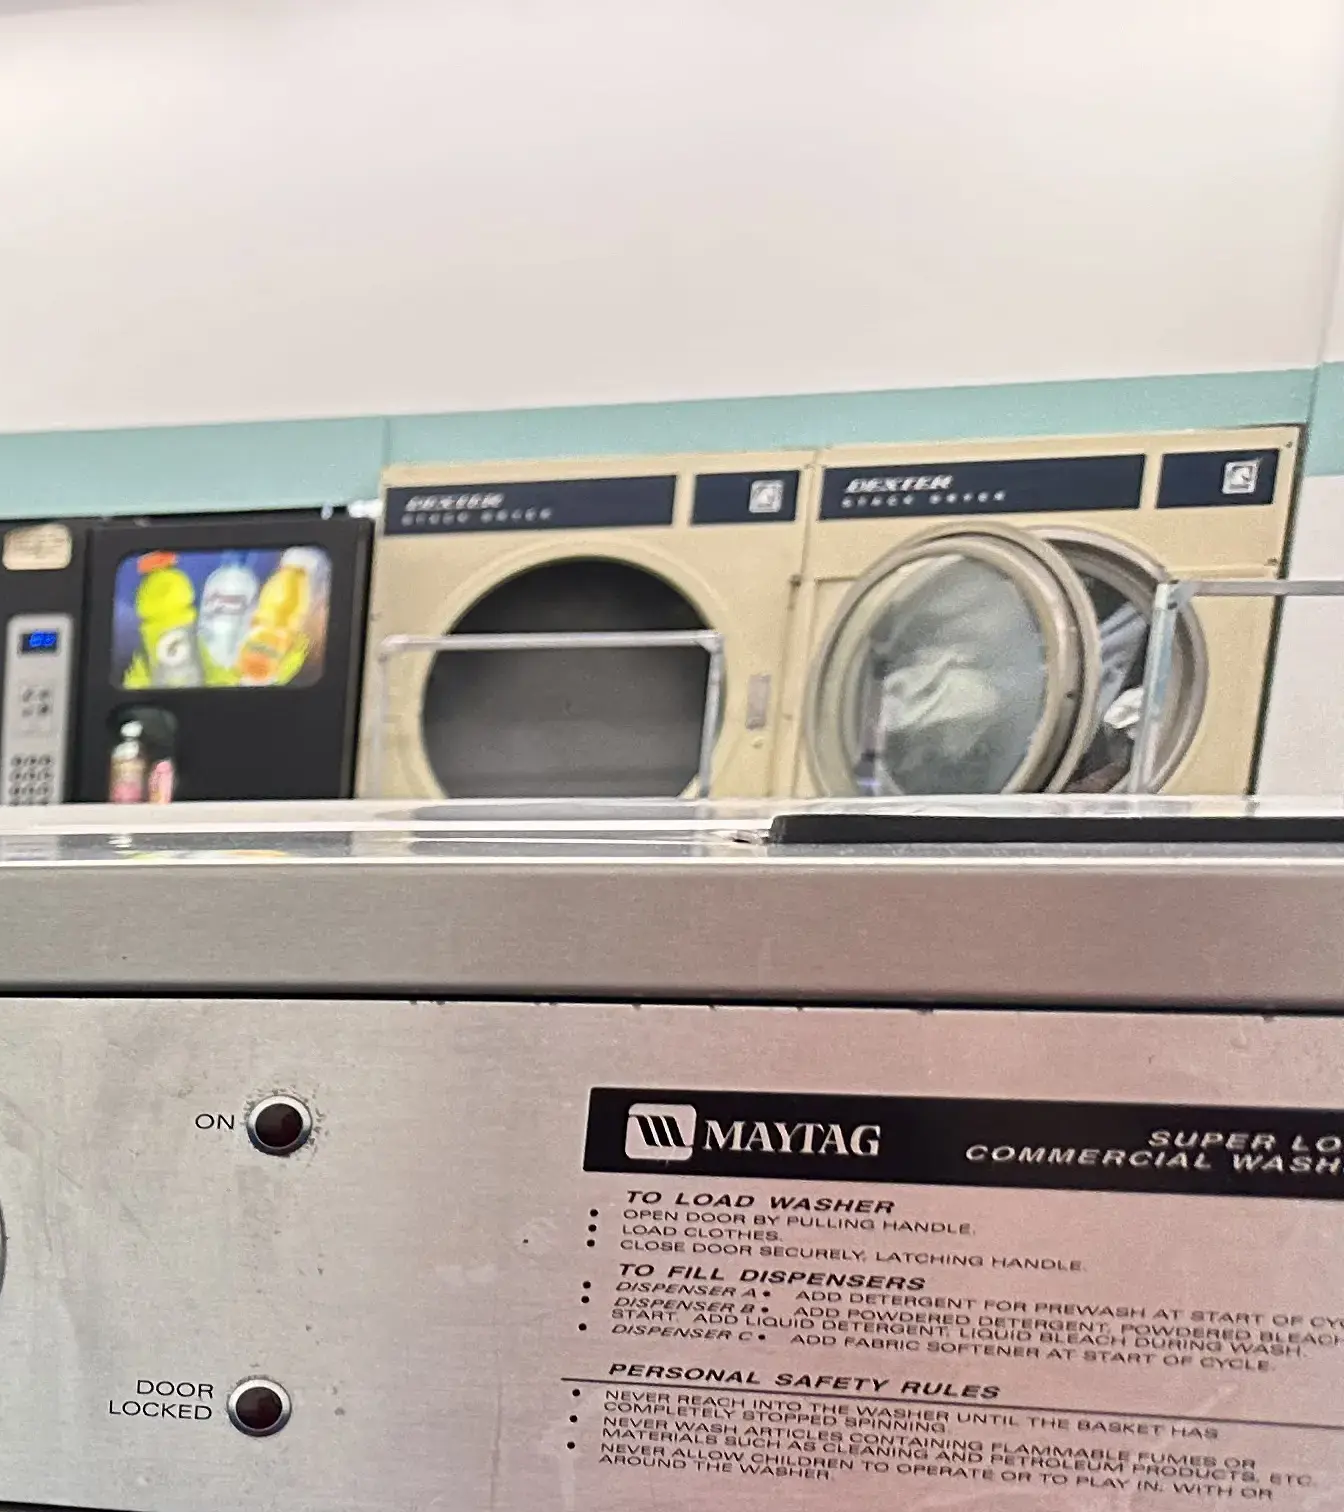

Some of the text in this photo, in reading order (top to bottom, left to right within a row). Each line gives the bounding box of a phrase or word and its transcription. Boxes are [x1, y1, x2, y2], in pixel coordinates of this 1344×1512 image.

[845, 475, 954, 493] DEXTER
[195, 1113, 235, 1131] ON
[703, 1118, 882, 1157] MAYTAG
[1148, 1130, 1344, 1155] SUPER LO
[966, 1144, 1344, 1175] COMMERCIAL WASH
[627, 1190, 895, 1214] TO LOAD WASHER
[622, 1225, 677, 1236] LOAD
[623, 1209, 678, 1221] OPEN
[686, 1212, 746, 1225] DOOR
[754, 1215, 780, 1226] BY
[787, 1216, 875, 1230] PULLING
[620, 1239, 685, 1252] CLOSE
[693, 1242, 752, 1256] DOOR
[876, 1251, 983, 1266] LATCHING
[620, 1263, 926, 1290] TO FILL DISPENSERS
[615, 1281, 1302, 1327] DISPENSER A ADD DETERGENT FOR PREWASH AT START OF
[612, 1324, 732, 1340] DISPENSER
[738, 1331, 752, 1341] C
[790, 1334, 836, 1346] ADD
[844, 1336, 920, 1352] FABRIC
[927, 1341, 1039, 1358] SOFTENER
[1046, 1348, 1078, 1360] AT
[1084, 1350, 1156, 1364] START
[1164, 1355, 1193, 1366] OF
[136, 1379, 214, 1399] DOOR
[609, 1363, 1000, 1398] PERSONAL SAFETY RULES
[109, 1400, 212, 1421] LOCKED
